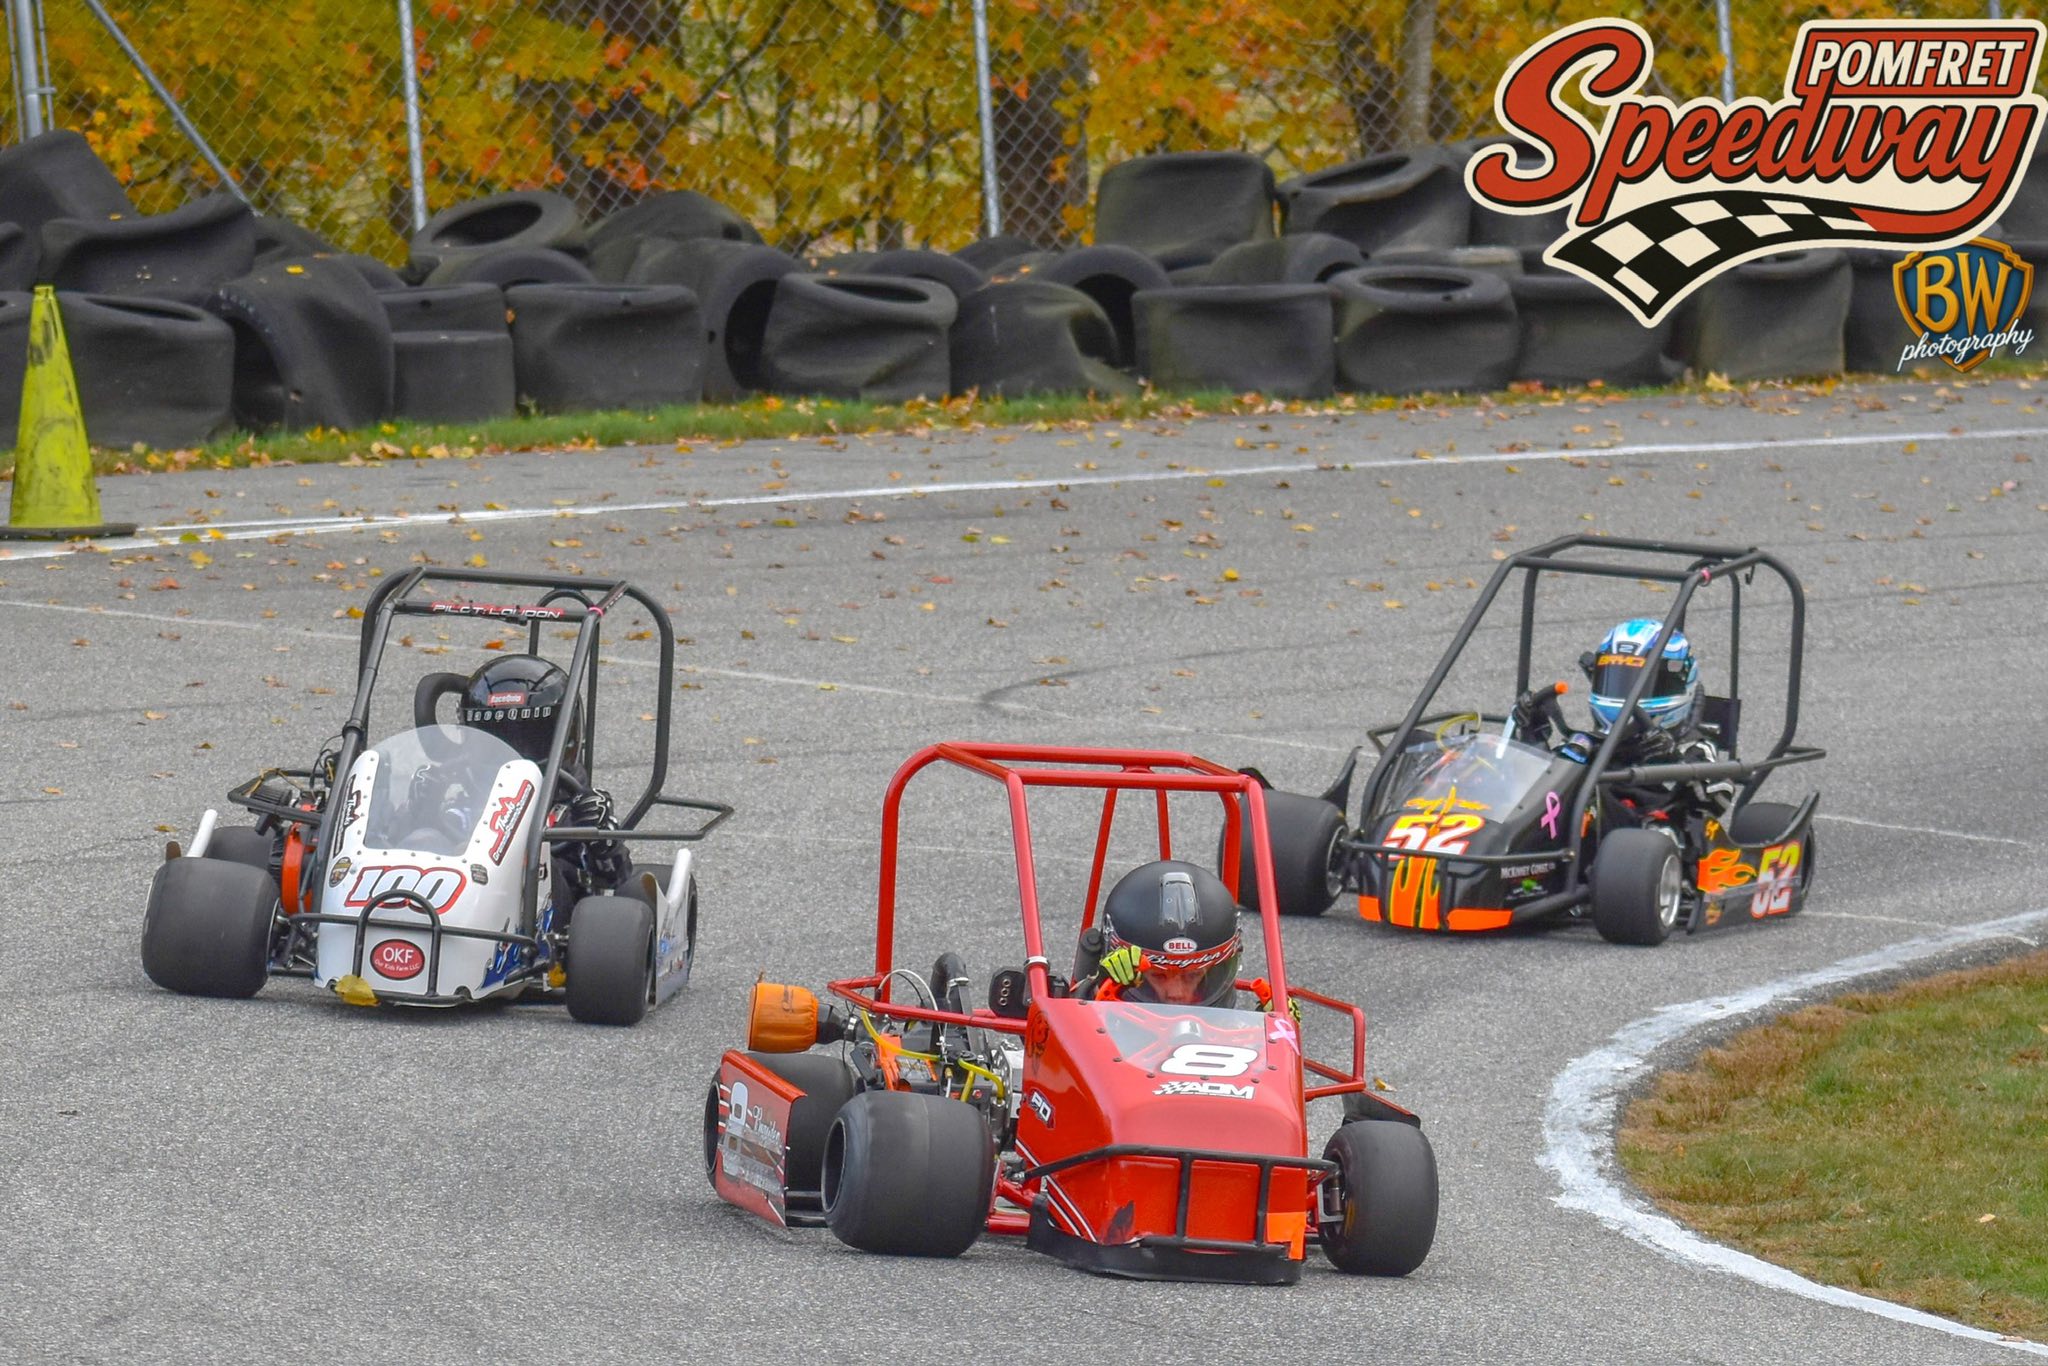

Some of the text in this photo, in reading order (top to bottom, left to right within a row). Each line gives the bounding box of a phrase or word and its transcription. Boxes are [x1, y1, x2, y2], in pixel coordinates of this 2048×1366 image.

[1377, 812, 1486, 860] 52
[344, 865, 467, 915] 100
[1750, 840, 1801, 919] 52
[383, 946, 414, 964] OKF
[1168, 942, 1194, 950] BELL
[1160, 1044, 1259, 1078] 8
